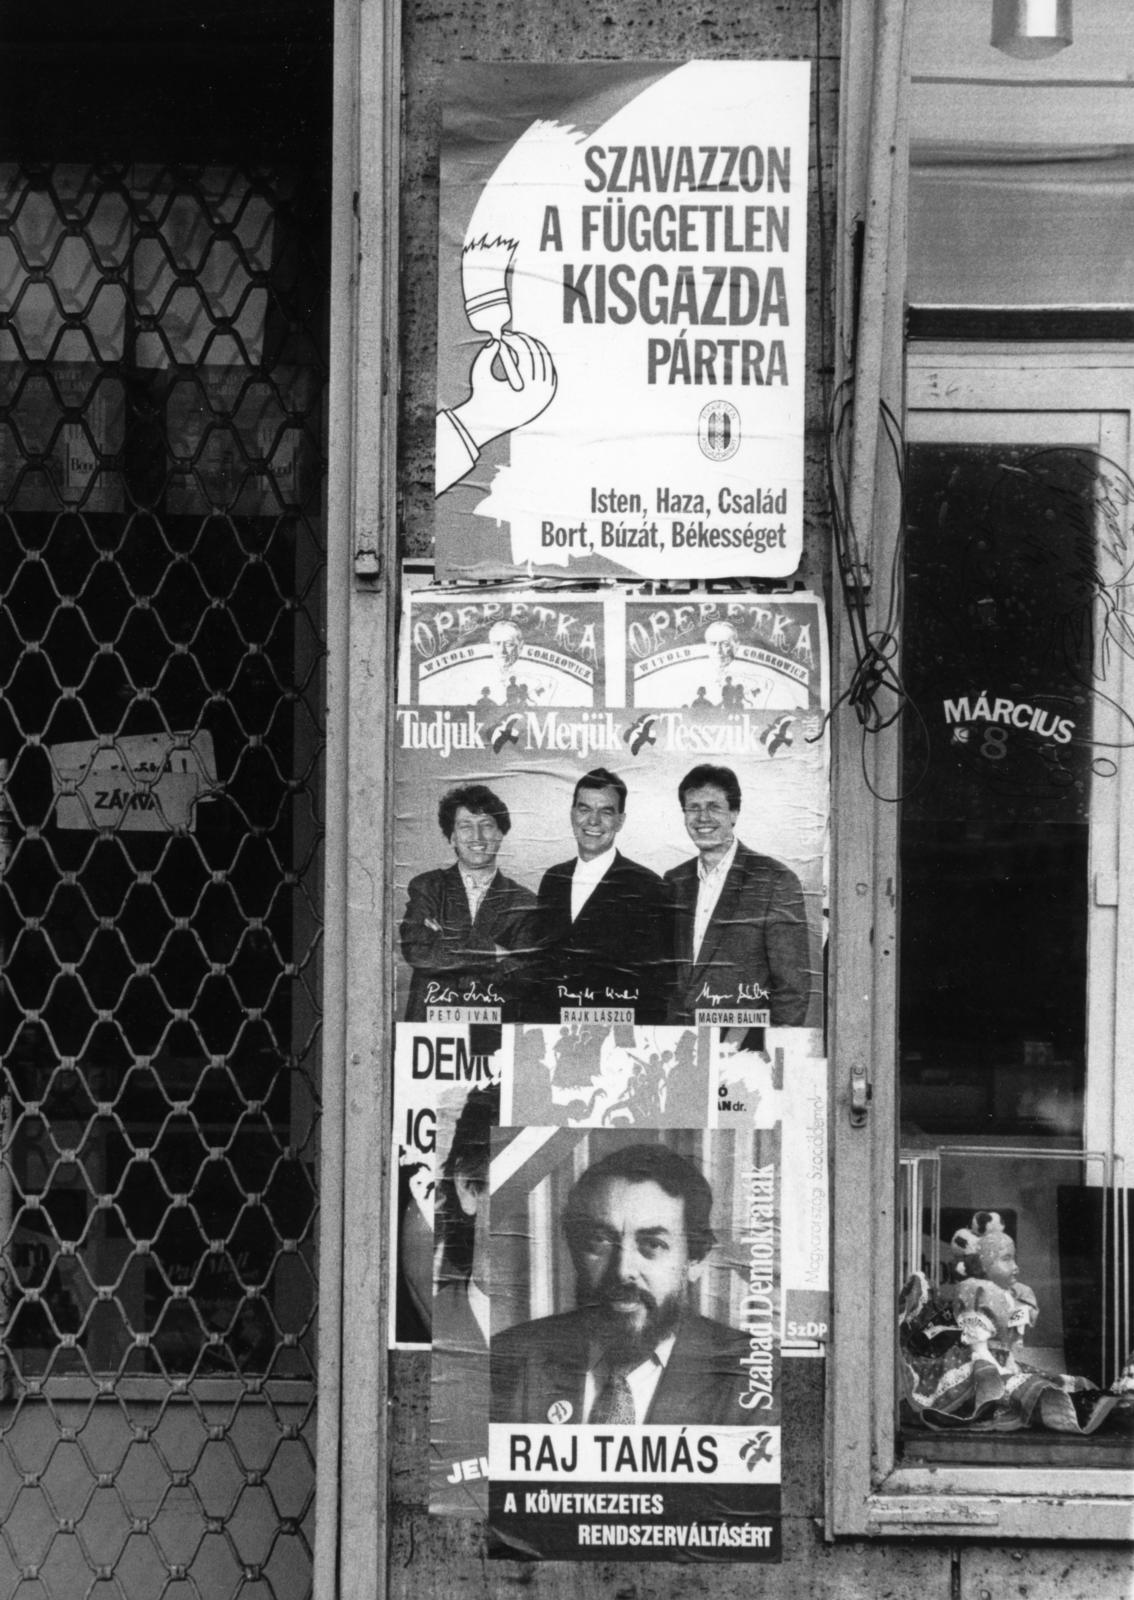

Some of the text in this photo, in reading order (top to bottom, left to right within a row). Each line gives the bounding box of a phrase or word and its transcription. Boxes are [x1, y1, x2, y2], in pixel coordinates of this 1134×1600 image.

[584, 145, 791, 193] SZAVAZZON
[539, 197, 790, 253] A FÜGGETLEN
[562, 264, 790, 327] KISGAZDA
[647, 329, 789, 386] PÁRTRA
[591, 487, 787, 520] Isten, Haza, Család
[541, 521, 787, 552] Bort, Búzát, Békességet
[414, 603, 599, 670] OPERETKA
[628, 603, 815, 670] OPERETKA
[424, 648, 475, 672] WITOLD
[639, 648, 691, 672] WITOLD
[943, 690, 1076, 744] MÁRCIUS
[397, 710, 761, 759] Tudjuk Merjük Tesszük
[980, 727, 1008, 760] 8
[468, 1009, 498, 1021] IVÁN
[564, 1010, 589, 1022] RAJK
[698, 1012, 734, 1024] MAGYAR
[732, 1100, 747, 1112] dr.
[738, 1163, 774, 1411] Szabad Demokraták
[787, 1320, 828, 1338] SzDP
[510, 1428, 719, 1473] RAJ TAMÁS
[504, 1490, 664, 1515] A KÖVETKEZETES
[578, 1521, 772, 1548] RENDSZERVÁLTÁSÉRT
